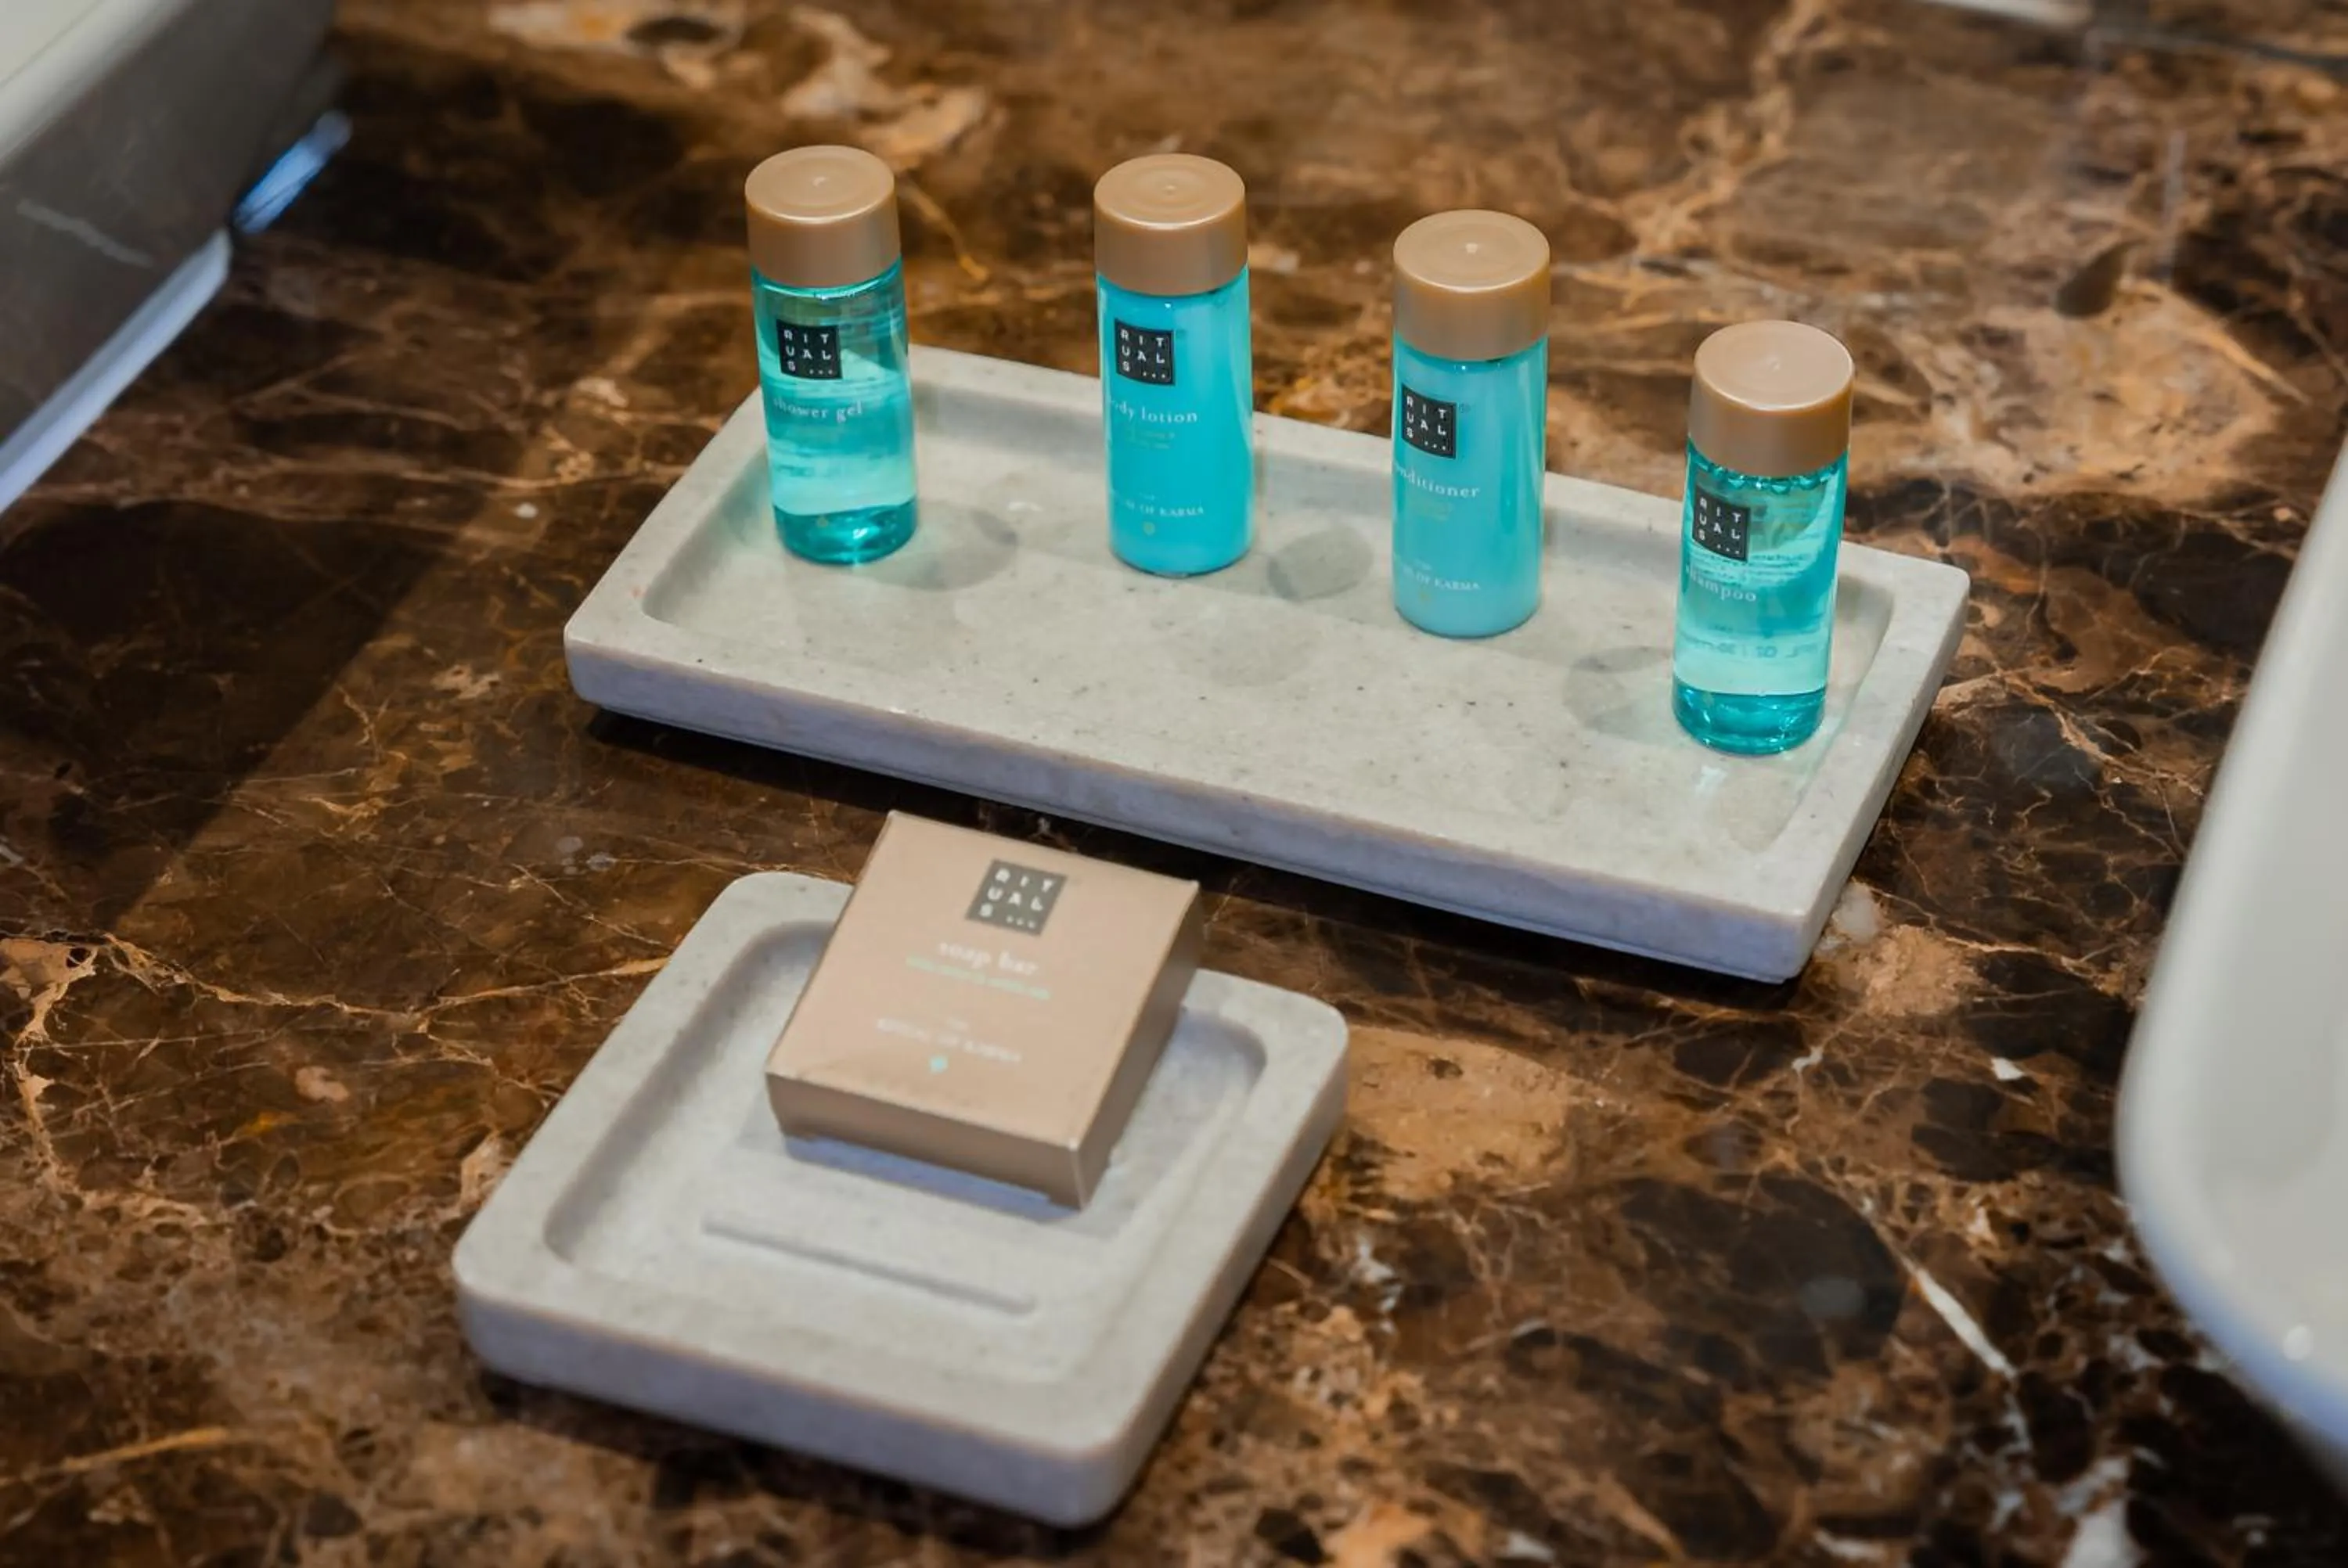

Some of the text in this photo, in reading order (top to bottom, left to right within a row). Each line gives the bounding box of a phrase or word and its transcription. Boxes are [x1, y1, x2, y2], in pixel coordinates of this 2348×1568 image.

[836, 400, 863, 423] gel
[1140, 406, 1198, 424] lotion
[1396, 462, 1480, 498] nditioner
